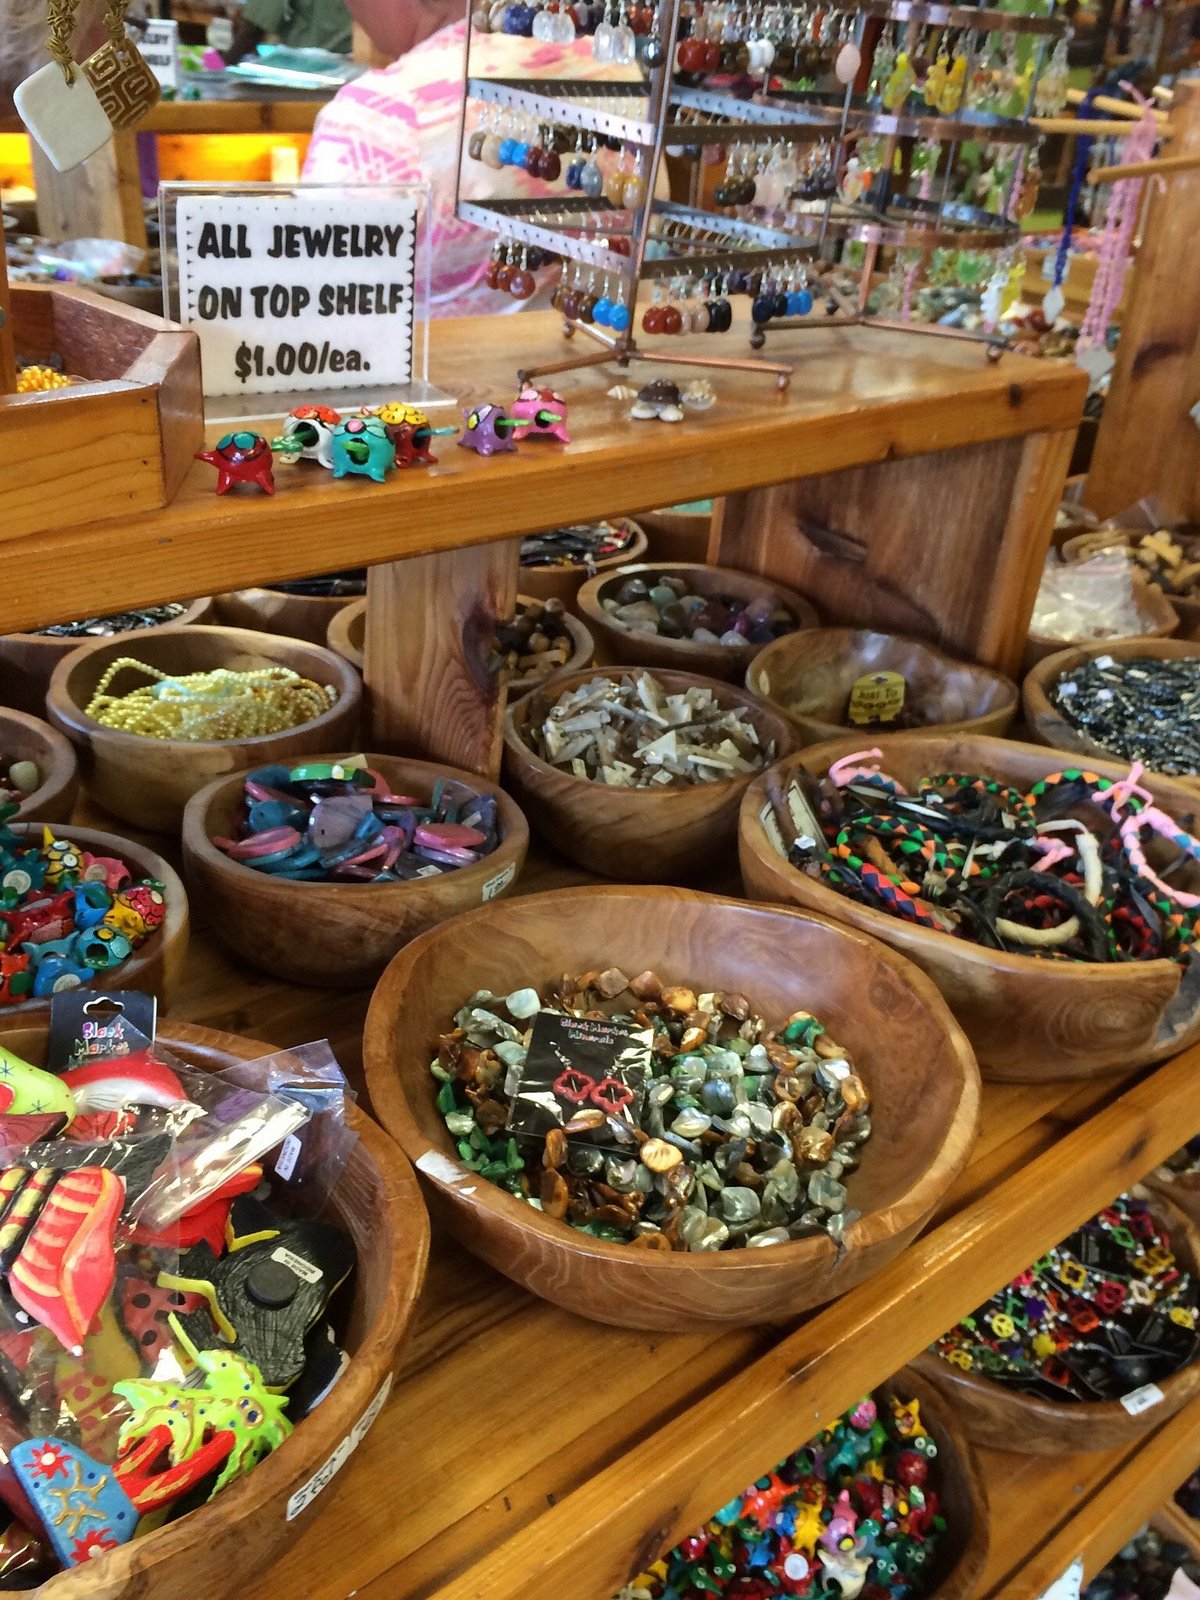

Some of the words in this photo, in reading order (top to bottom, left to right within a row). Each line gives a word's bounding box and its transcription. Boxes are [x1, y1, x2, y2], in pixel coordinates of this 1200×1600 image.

[197, 221, 252, 259] ALL
[267, 223, 404, 259] JEWELRY
[198, 285, 242, 320] ON
[250, 284, 310, 319] TOP
[318, 282, 404, 317] SHELF
[235, 341, 371, 383] $1.00/ea.
[82, 1021, 125, 1040] Black
